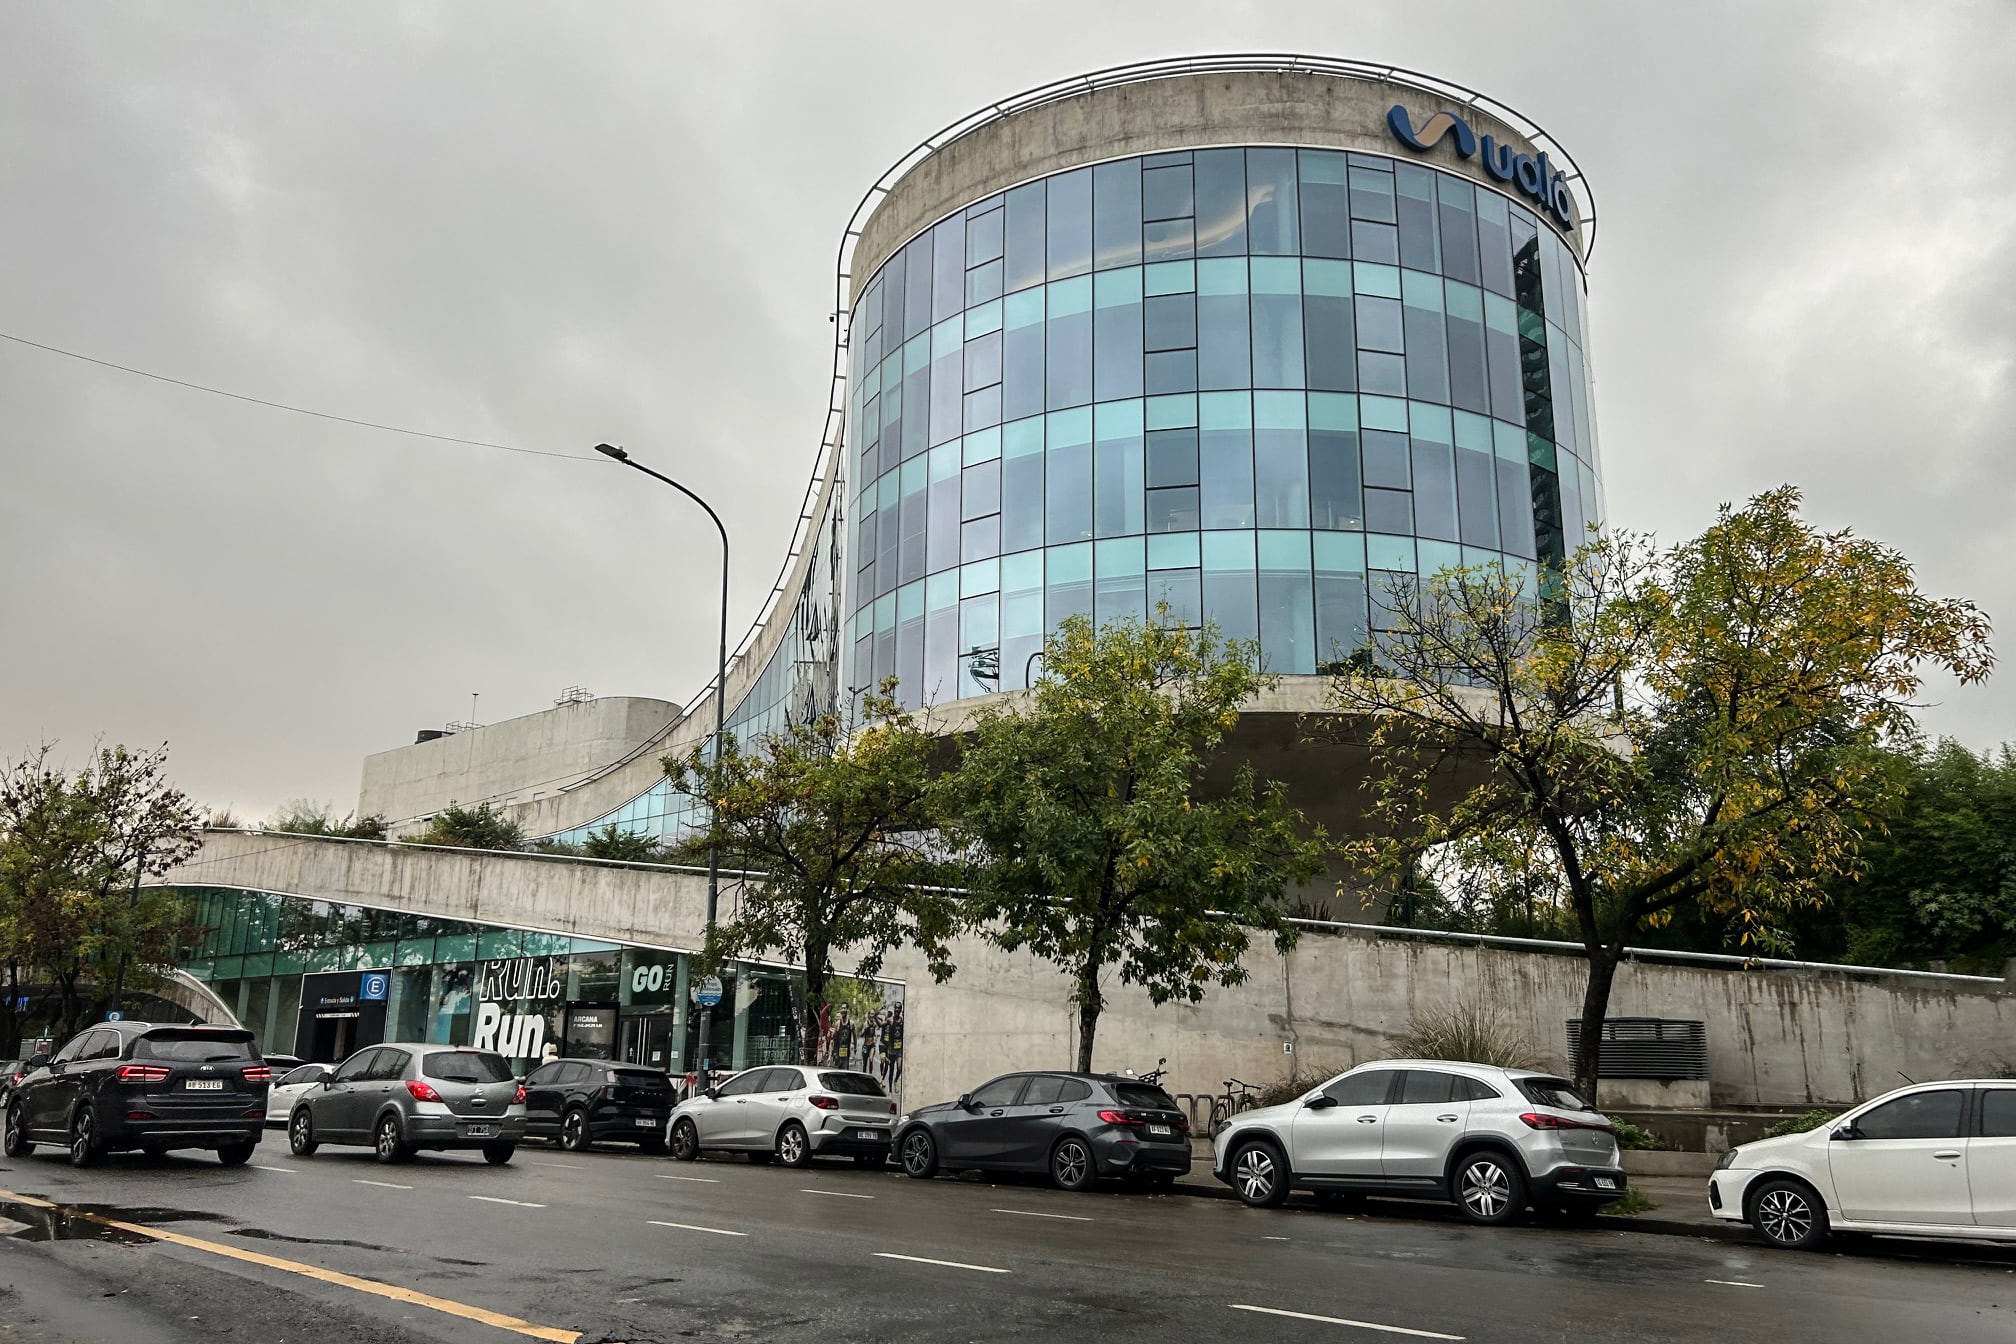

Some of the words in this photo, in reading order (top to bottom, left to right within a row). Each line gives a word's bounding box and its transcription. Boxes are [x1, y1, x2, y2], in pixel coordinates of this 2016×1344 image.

[632, 964, 664, 993] GO
[662, 963, 675, 992] RUN
[573, 1015, 598, 1023] ARCANA
